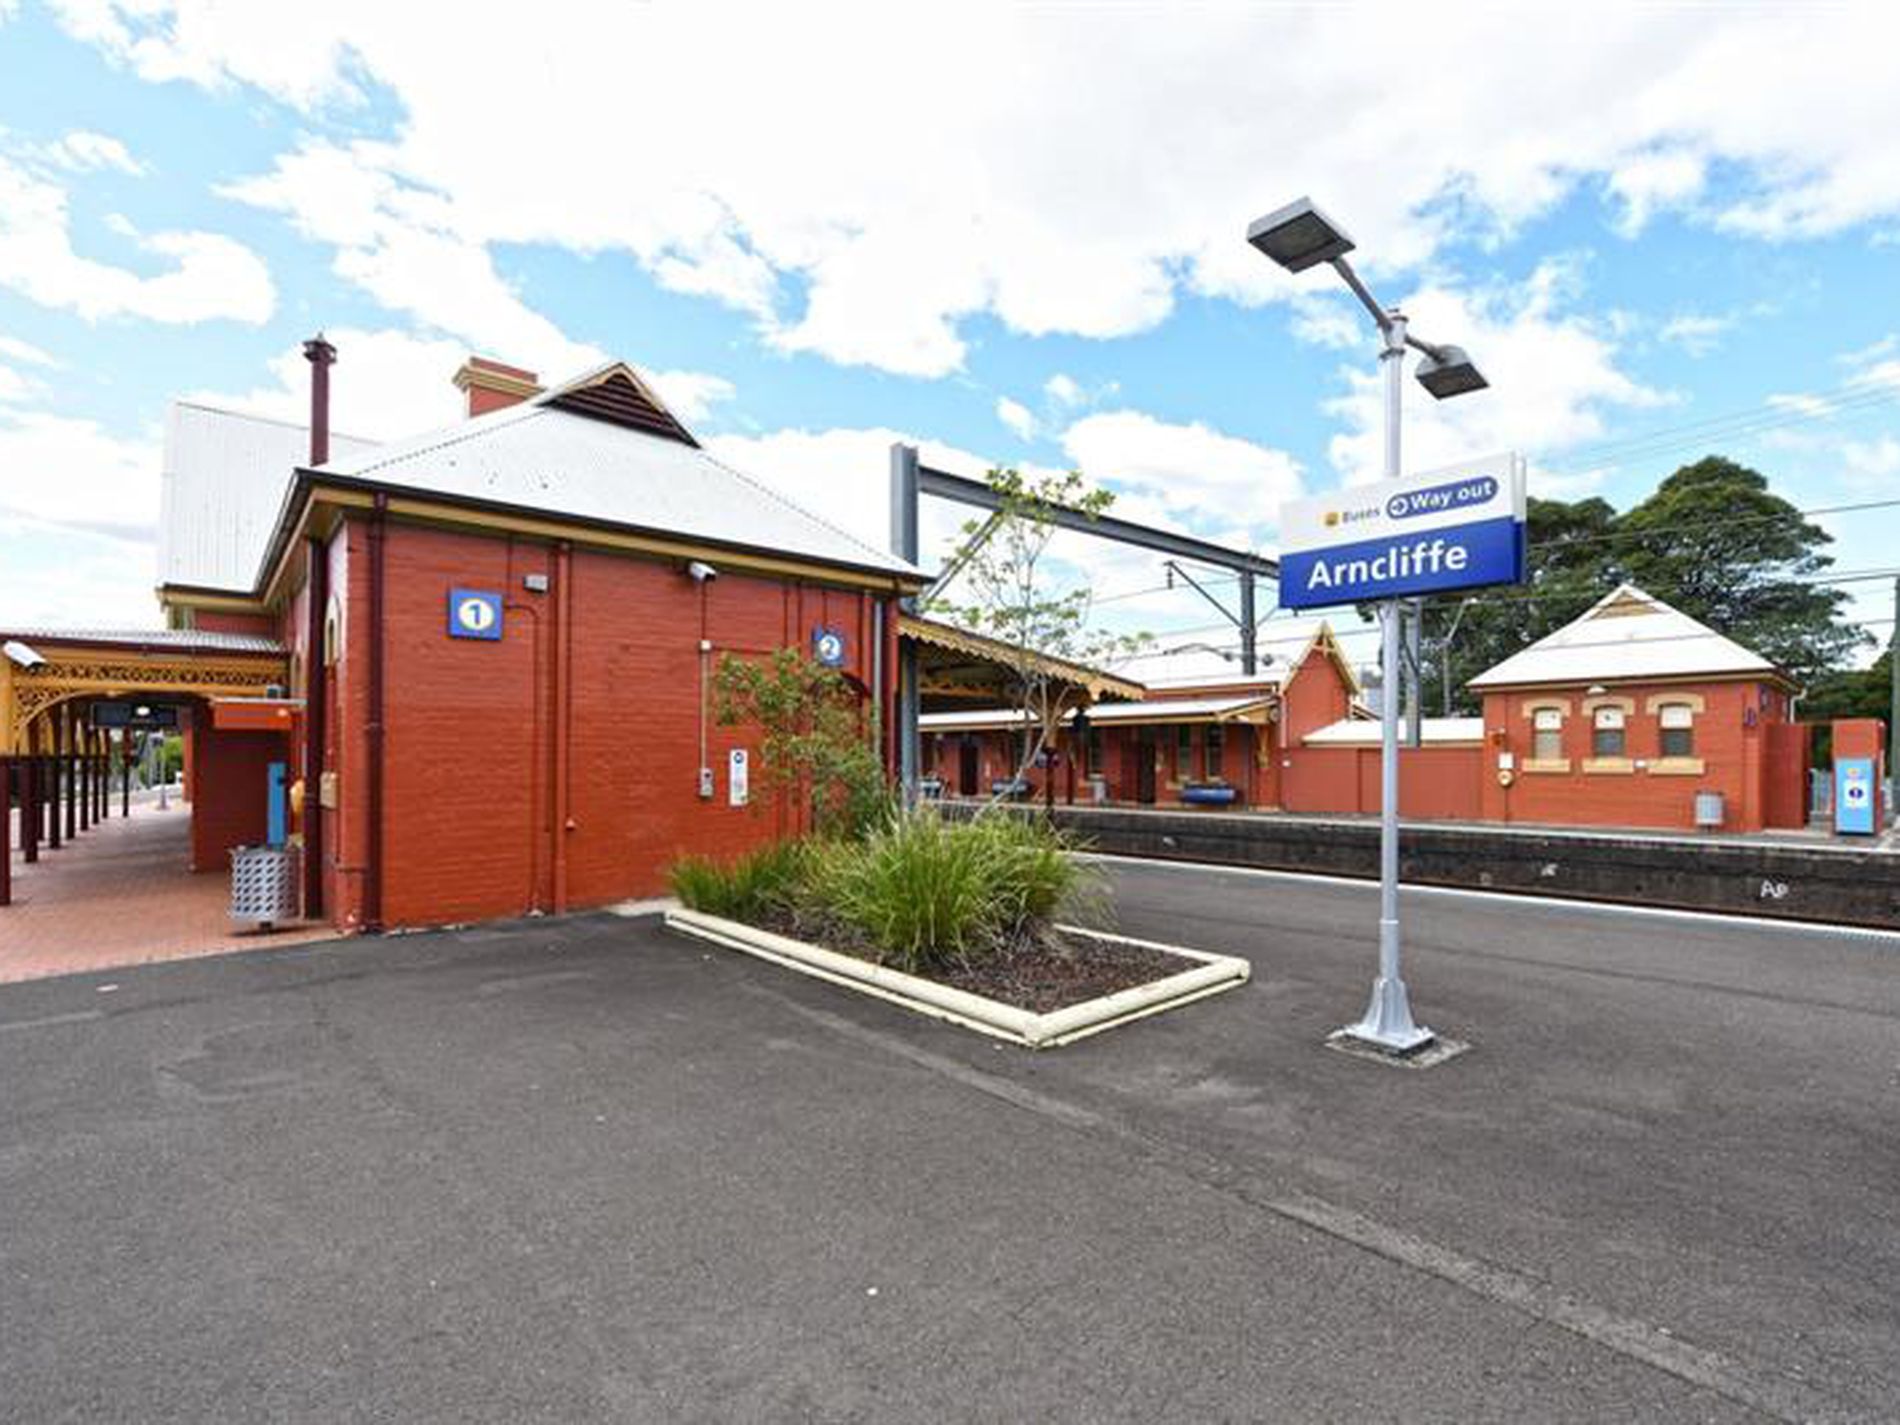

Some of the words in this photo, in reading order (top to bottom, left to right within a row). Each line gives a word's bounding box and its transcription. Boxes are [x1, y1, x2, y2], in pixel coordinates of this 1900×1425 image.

[1410, 490, 1452, 510] Way
[1457, 480, 1493, 501] out
[1307, 539, 1468, 591] Arncliffe
[468, 603, 481, 625] 1
[824, 638, 836, 657] 2
